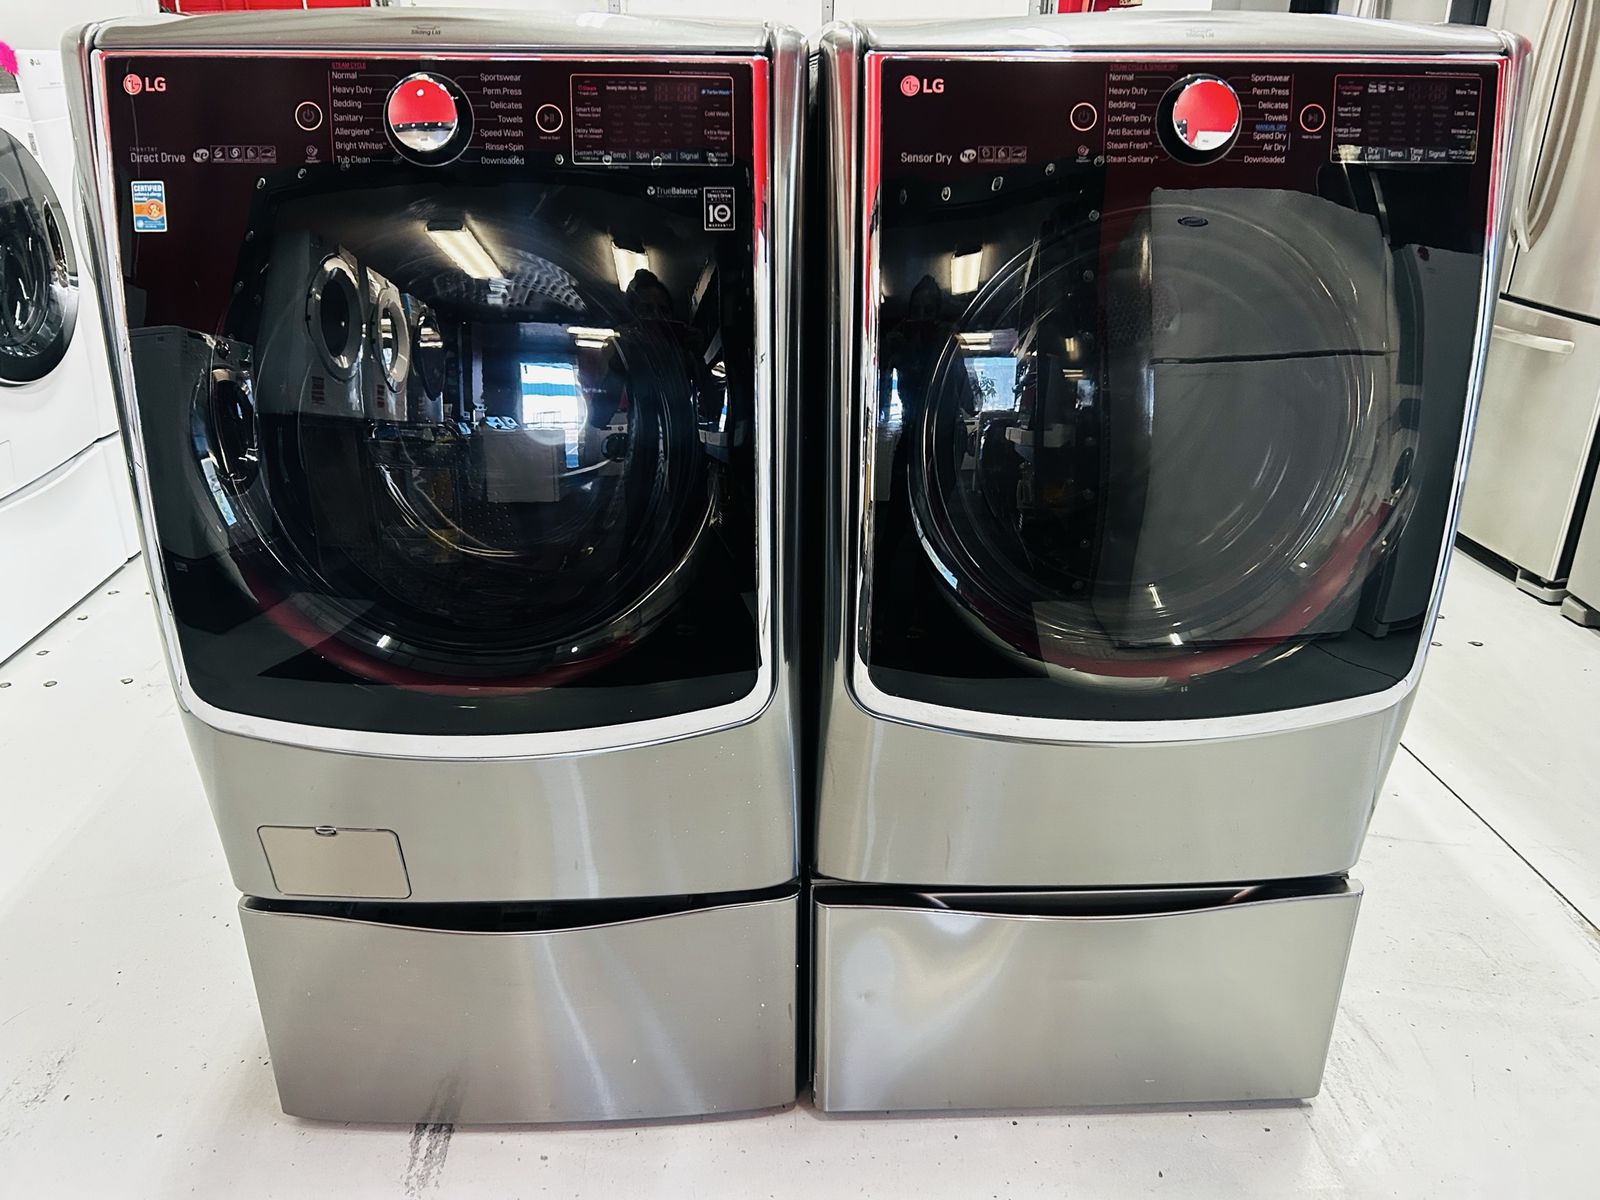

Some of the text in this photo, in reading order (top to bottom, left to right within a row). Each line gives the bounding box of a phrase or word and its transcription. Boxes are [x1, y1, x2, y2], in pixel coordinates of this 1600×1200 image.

[332, 72, 357, 80] Normal
[480, 73, 521, 82] Sportswear
[1109, 73, 1134, 81] Normal
[1251, 73, 1290, 82] Sportswear
[145, 77, 166, 92] LG
[923, 78, 945, 93] LG
[333, 86, 373, 95] Heavy Duty
[1109, 87, 1148, 96] Heavy Duty
[333, 100, 362, 109] Bedding
[490, 101, 522, 110] Delicates
[1108, 100, 1136, 110] Bedding
[1258, 101, 1289, 109] Delicates
[334, 114, 363, 123] Sanitary
[704, 110, 730, 118] Cold Wash
[1140, 114, 1152, 123] Dry
[1264, 114, 1288, 122] Towels
[498, 115, 523, 123] Towels
[574, 127, 588, 135] Delay
[1108, 127, 1150, 136] Anti Bacterial
[1255, 123, 1287, 131] MANUAL DRY
[480, 129, 524, 138] Speed Wash
[1253, 132, 1287, 141] Speed Dry
[336, 142, 357, 151] Bright
[485, 143, 524, 152] Rinse+Spin
[1107, 141, 1126, 149] Steam
[1262, 143, 1287, 152] Air Dry
[1367, 147, 1378, 155] Dry
[1428, 150, 1446, 159] Signal
[131, 152, 186, 163] Direct Drive
[336, 156, 371, 164] Tub Clean
[481, 156, 525, 165] Downloaded
[635, 151, 650, 161] Spin
[660, 152, 672, 160] Soil
[680, 151, 699, 161] Signal
[901, 152, 952, 165] Sensor Dry
[1106, 155, 1126, 163] Steam
[1244, 155, 1285, 164] Downloaded
[1410, 153, 1422, 162] Dry
[133, 184, 162, 192] CERTIFIED
[708, 204, 731, 223] 10
